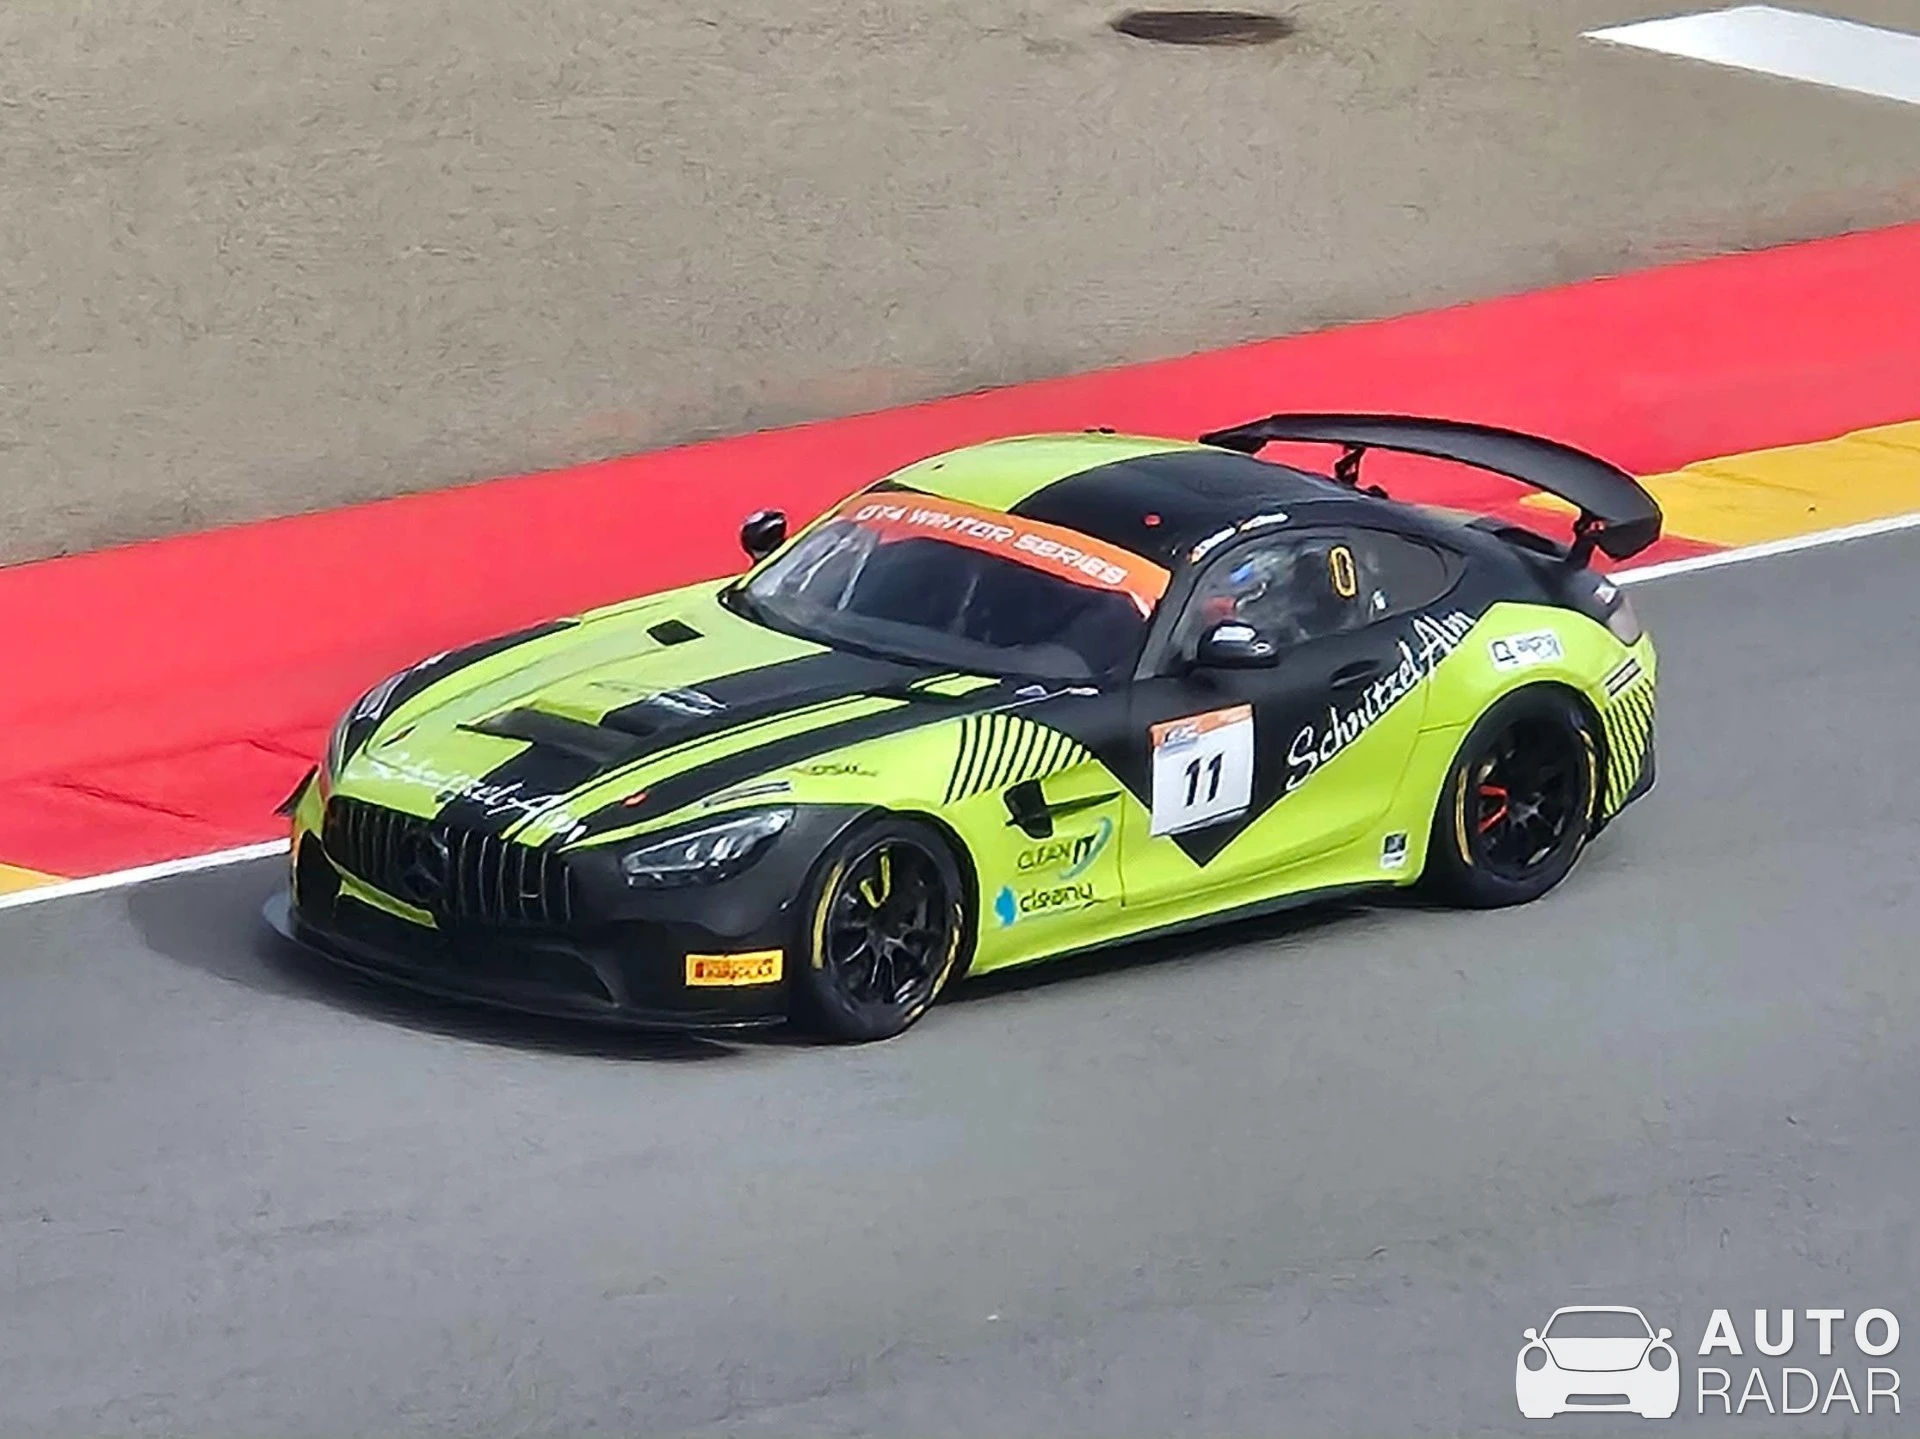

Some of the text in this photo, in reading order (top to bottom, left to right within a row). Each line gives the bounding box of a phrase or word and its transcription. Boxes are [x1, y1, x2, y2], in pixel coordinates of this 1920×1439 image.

[907, 508, 1015, 543] WINTER
[1012, 532, 1127, 585] SERIES
[1185, 751, 1224, 808] 11
